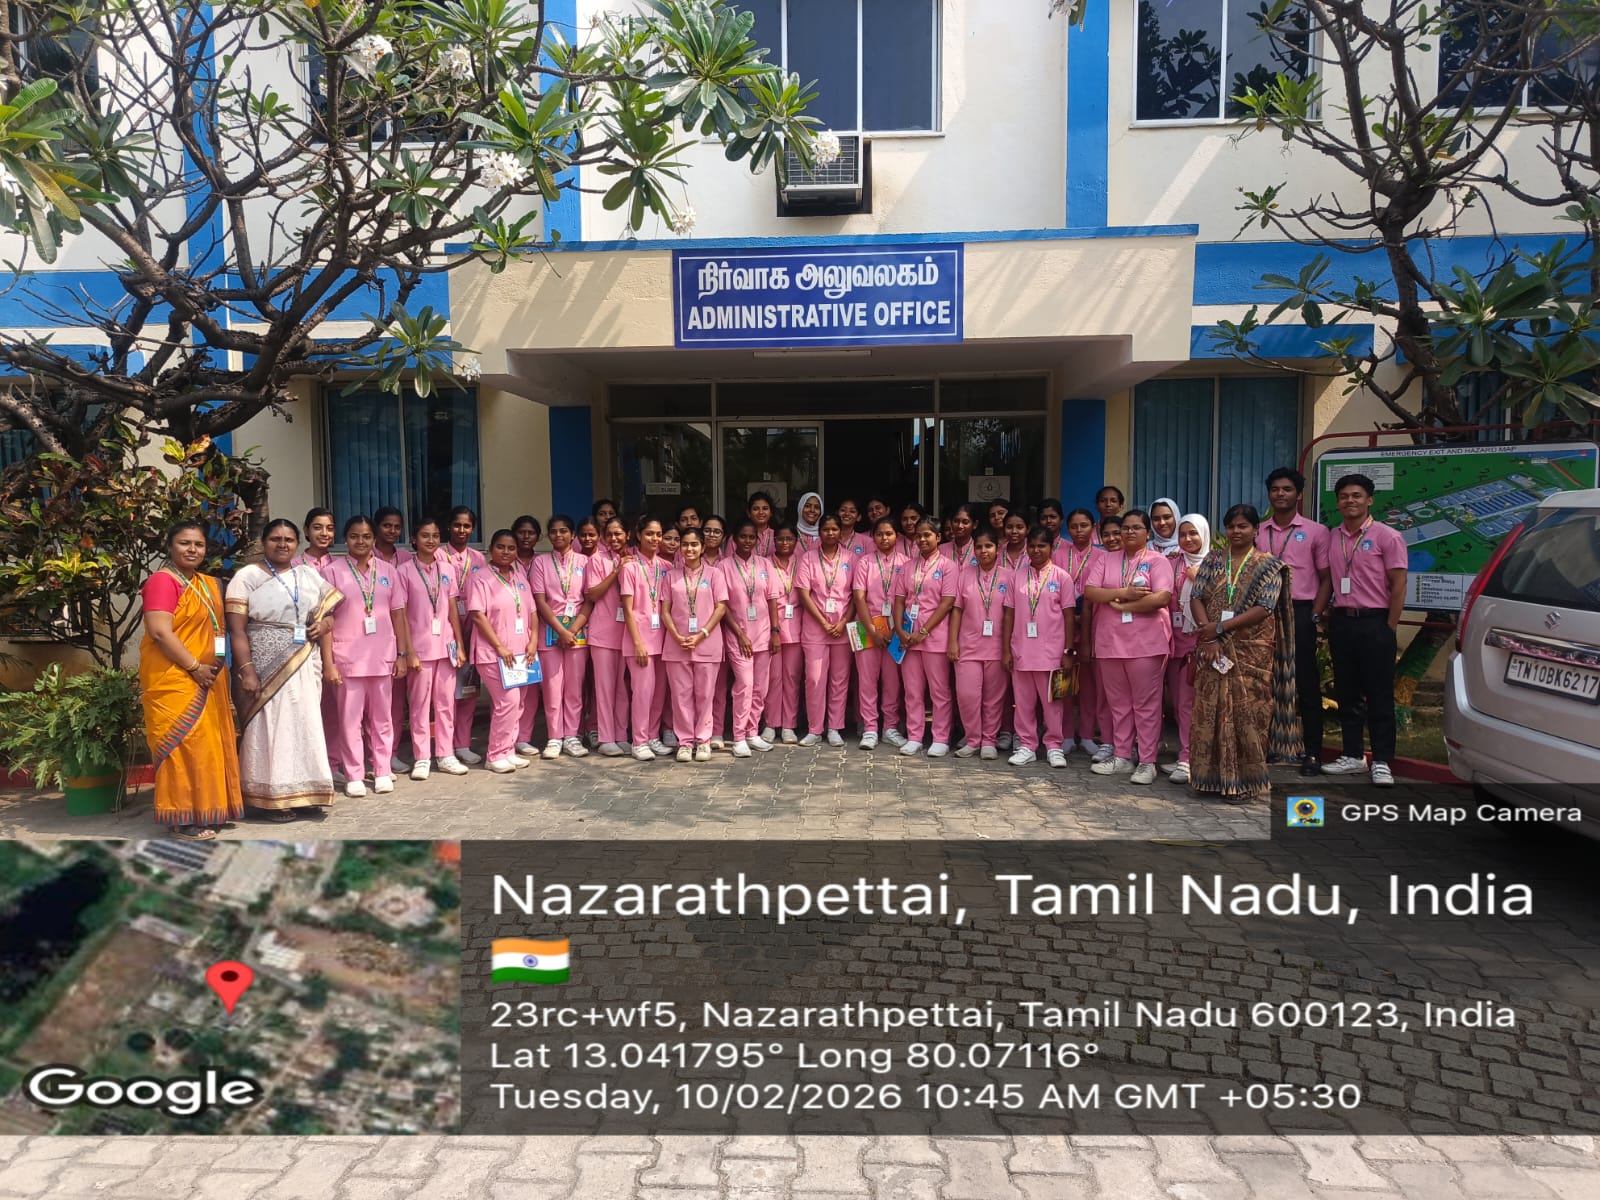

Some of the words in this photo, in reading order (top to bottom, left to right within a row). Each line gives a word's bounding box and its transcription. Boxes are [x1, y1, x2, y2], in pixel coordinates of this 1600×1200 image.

[698, 260, 790, 300] நிர்வாக
[795, 255, 939, 299] அலுவலகம்
[687, 302, 868, 331] ADMINISTRATIVE
[873, 300, 951, 327] OFFICE
[1380, 449, 1427, 457] EMERGENCY
[1446, 447, 1463, 455] AND
[1463, 446, 1497, 454] HAZARD
[1516, 660, 1599, 695] TN10BK6217
